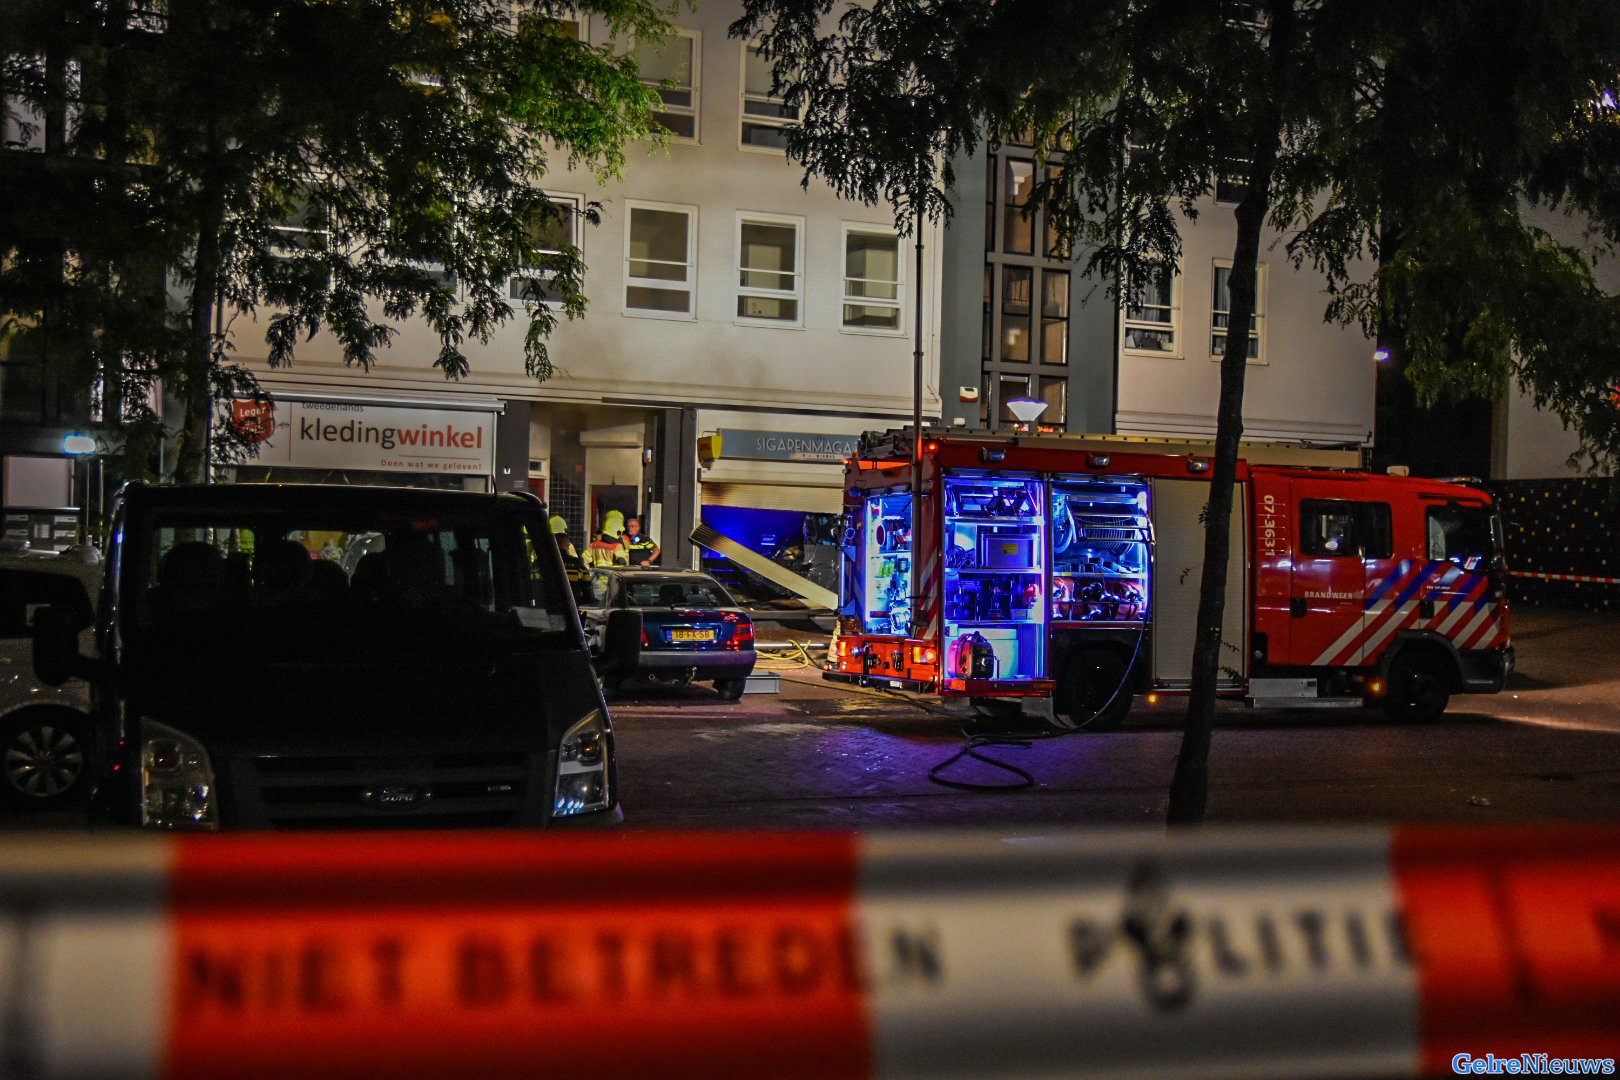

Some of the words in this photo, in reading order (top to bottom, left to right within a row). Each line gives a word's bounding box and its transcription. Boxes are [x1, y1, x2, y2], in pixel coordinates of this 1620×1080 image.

[240, 407, 267, 418] Leger
[300, 417, 483, 450] kledingwinkel
[756, 436, 857, 455] SIGARENMAGA
[381, 459, 404, 467] Doen
[443, 462, 482, 471] geloven!
[1263, 494, 1276, 556] 07-3631
[1304, 590, 1353, 600] BRANDWEER
